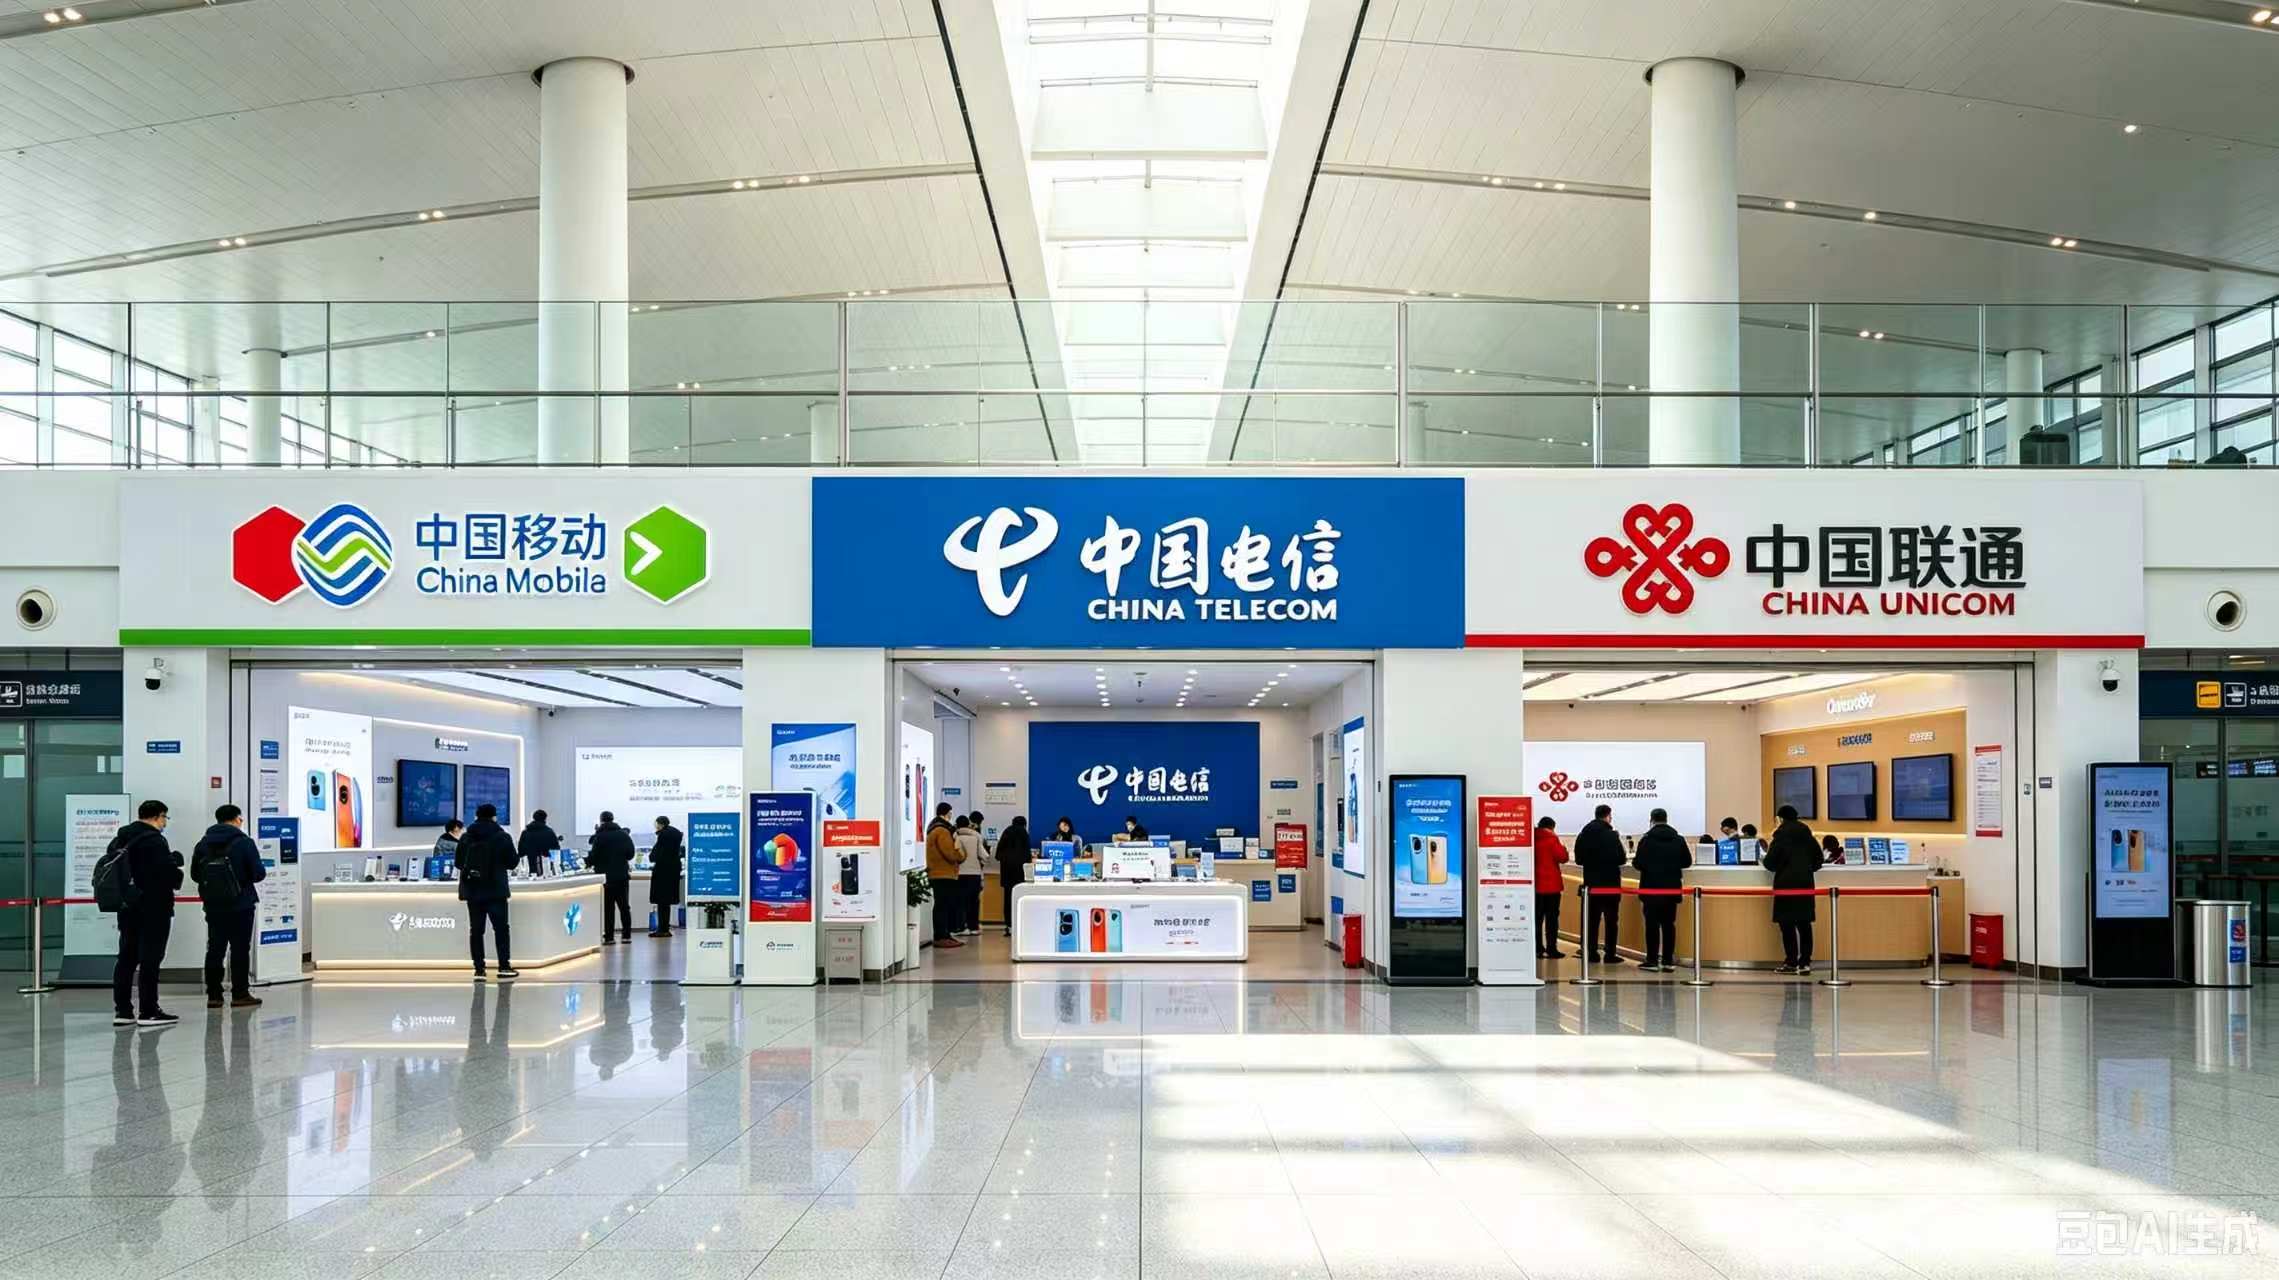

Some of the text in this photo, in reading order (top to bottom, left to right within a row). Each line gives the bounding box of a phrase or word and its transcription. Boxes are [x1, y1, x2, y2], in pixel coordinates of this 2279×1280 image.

[416, 513, 606, 561] 中国移动
[1080, 515, 1342, 597] 中国电信
[1746, 524, 2027, 588] 中国联通
[416, 567, 498, 593] China
[1087, 599, 1337, 620] CHINA TELECOM
[1762, 592, 2015, 616] CHINA UNICOM
